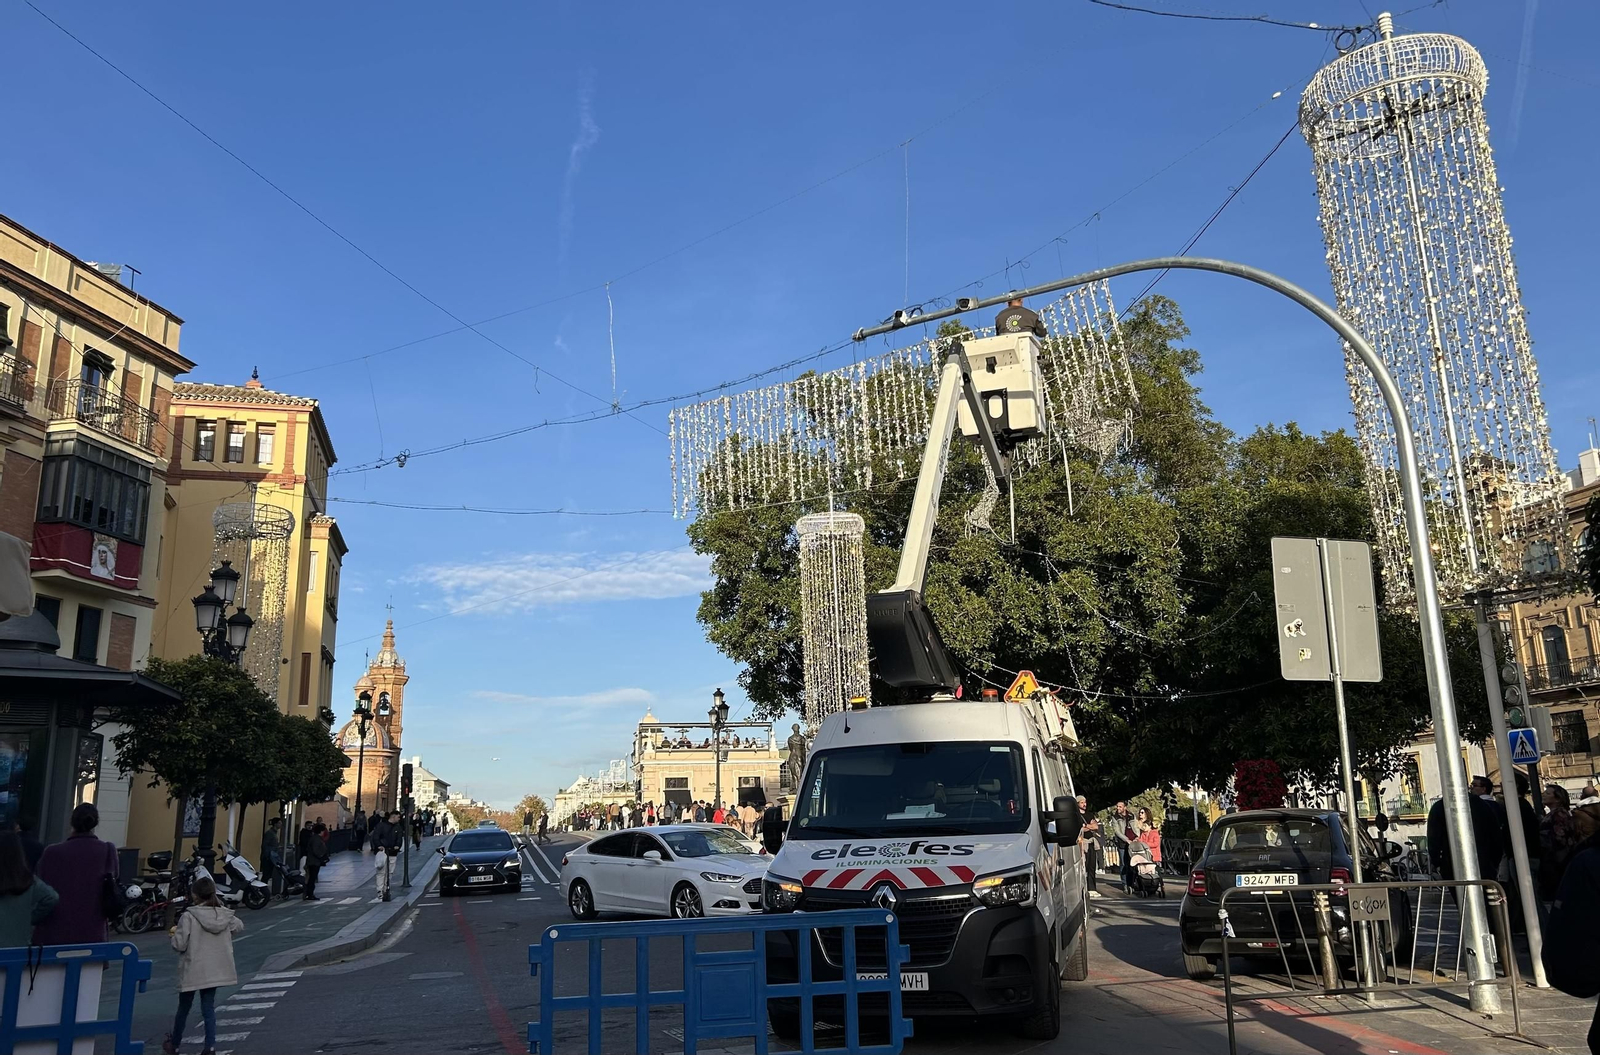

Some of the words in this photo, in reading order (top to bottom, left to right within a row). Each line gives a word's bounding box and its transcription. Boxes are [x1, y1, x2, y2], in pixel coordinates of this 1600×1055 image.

[836, 858, 938, 868] ILUMINACIONES
[1259, 854, 1271, 863] FIAT
[1244, 875, 1270, 885] 9247
[1274, 875, 1295, 885] MFB
